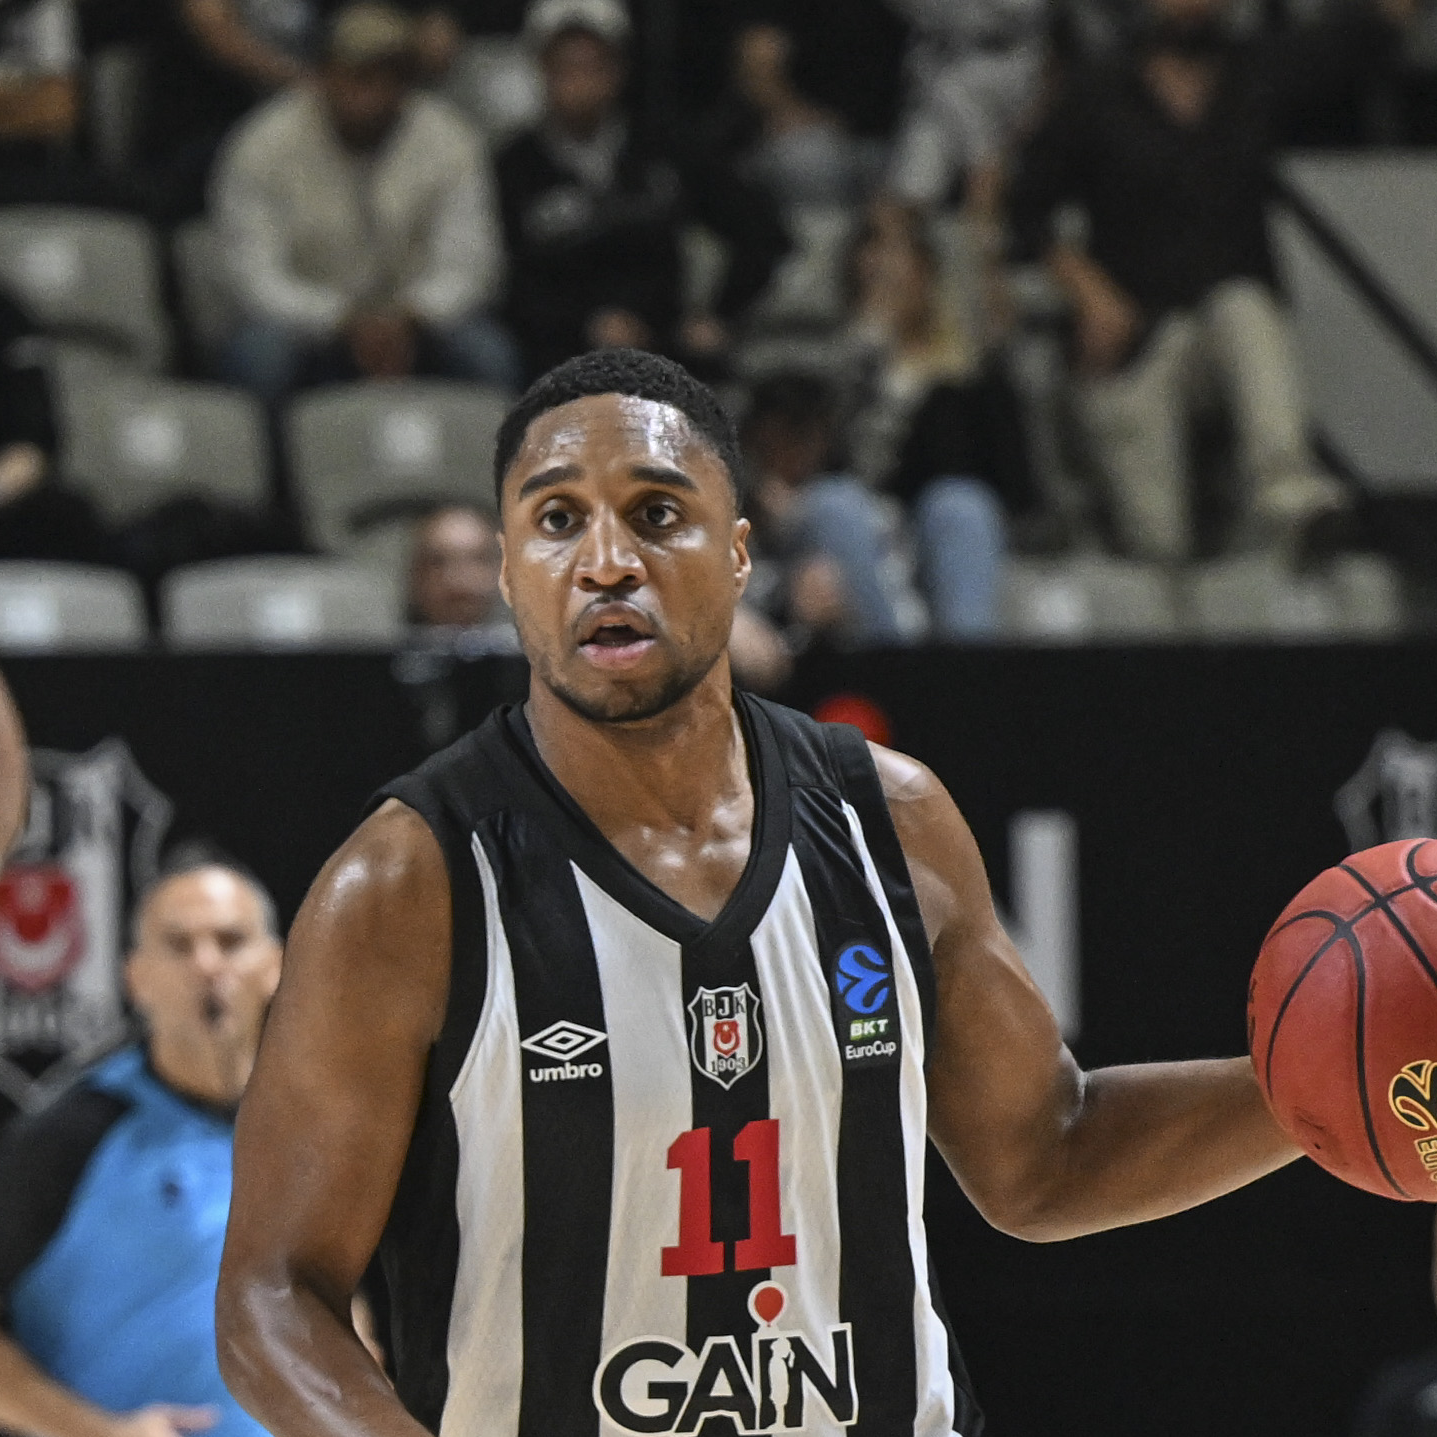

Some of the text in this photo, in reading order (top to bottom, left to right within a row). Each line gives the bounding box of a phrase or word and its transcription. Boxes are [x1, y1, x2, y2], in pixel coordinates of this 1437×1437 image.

[704, 995, 746, 1017] BJK
[849, 1018, 889, 1037] BKT
[845, 1040, 897, 1060] EuroCup
[529, 1061, 603, 1083] umbro
[660, 1118, 797, 1277] 11
